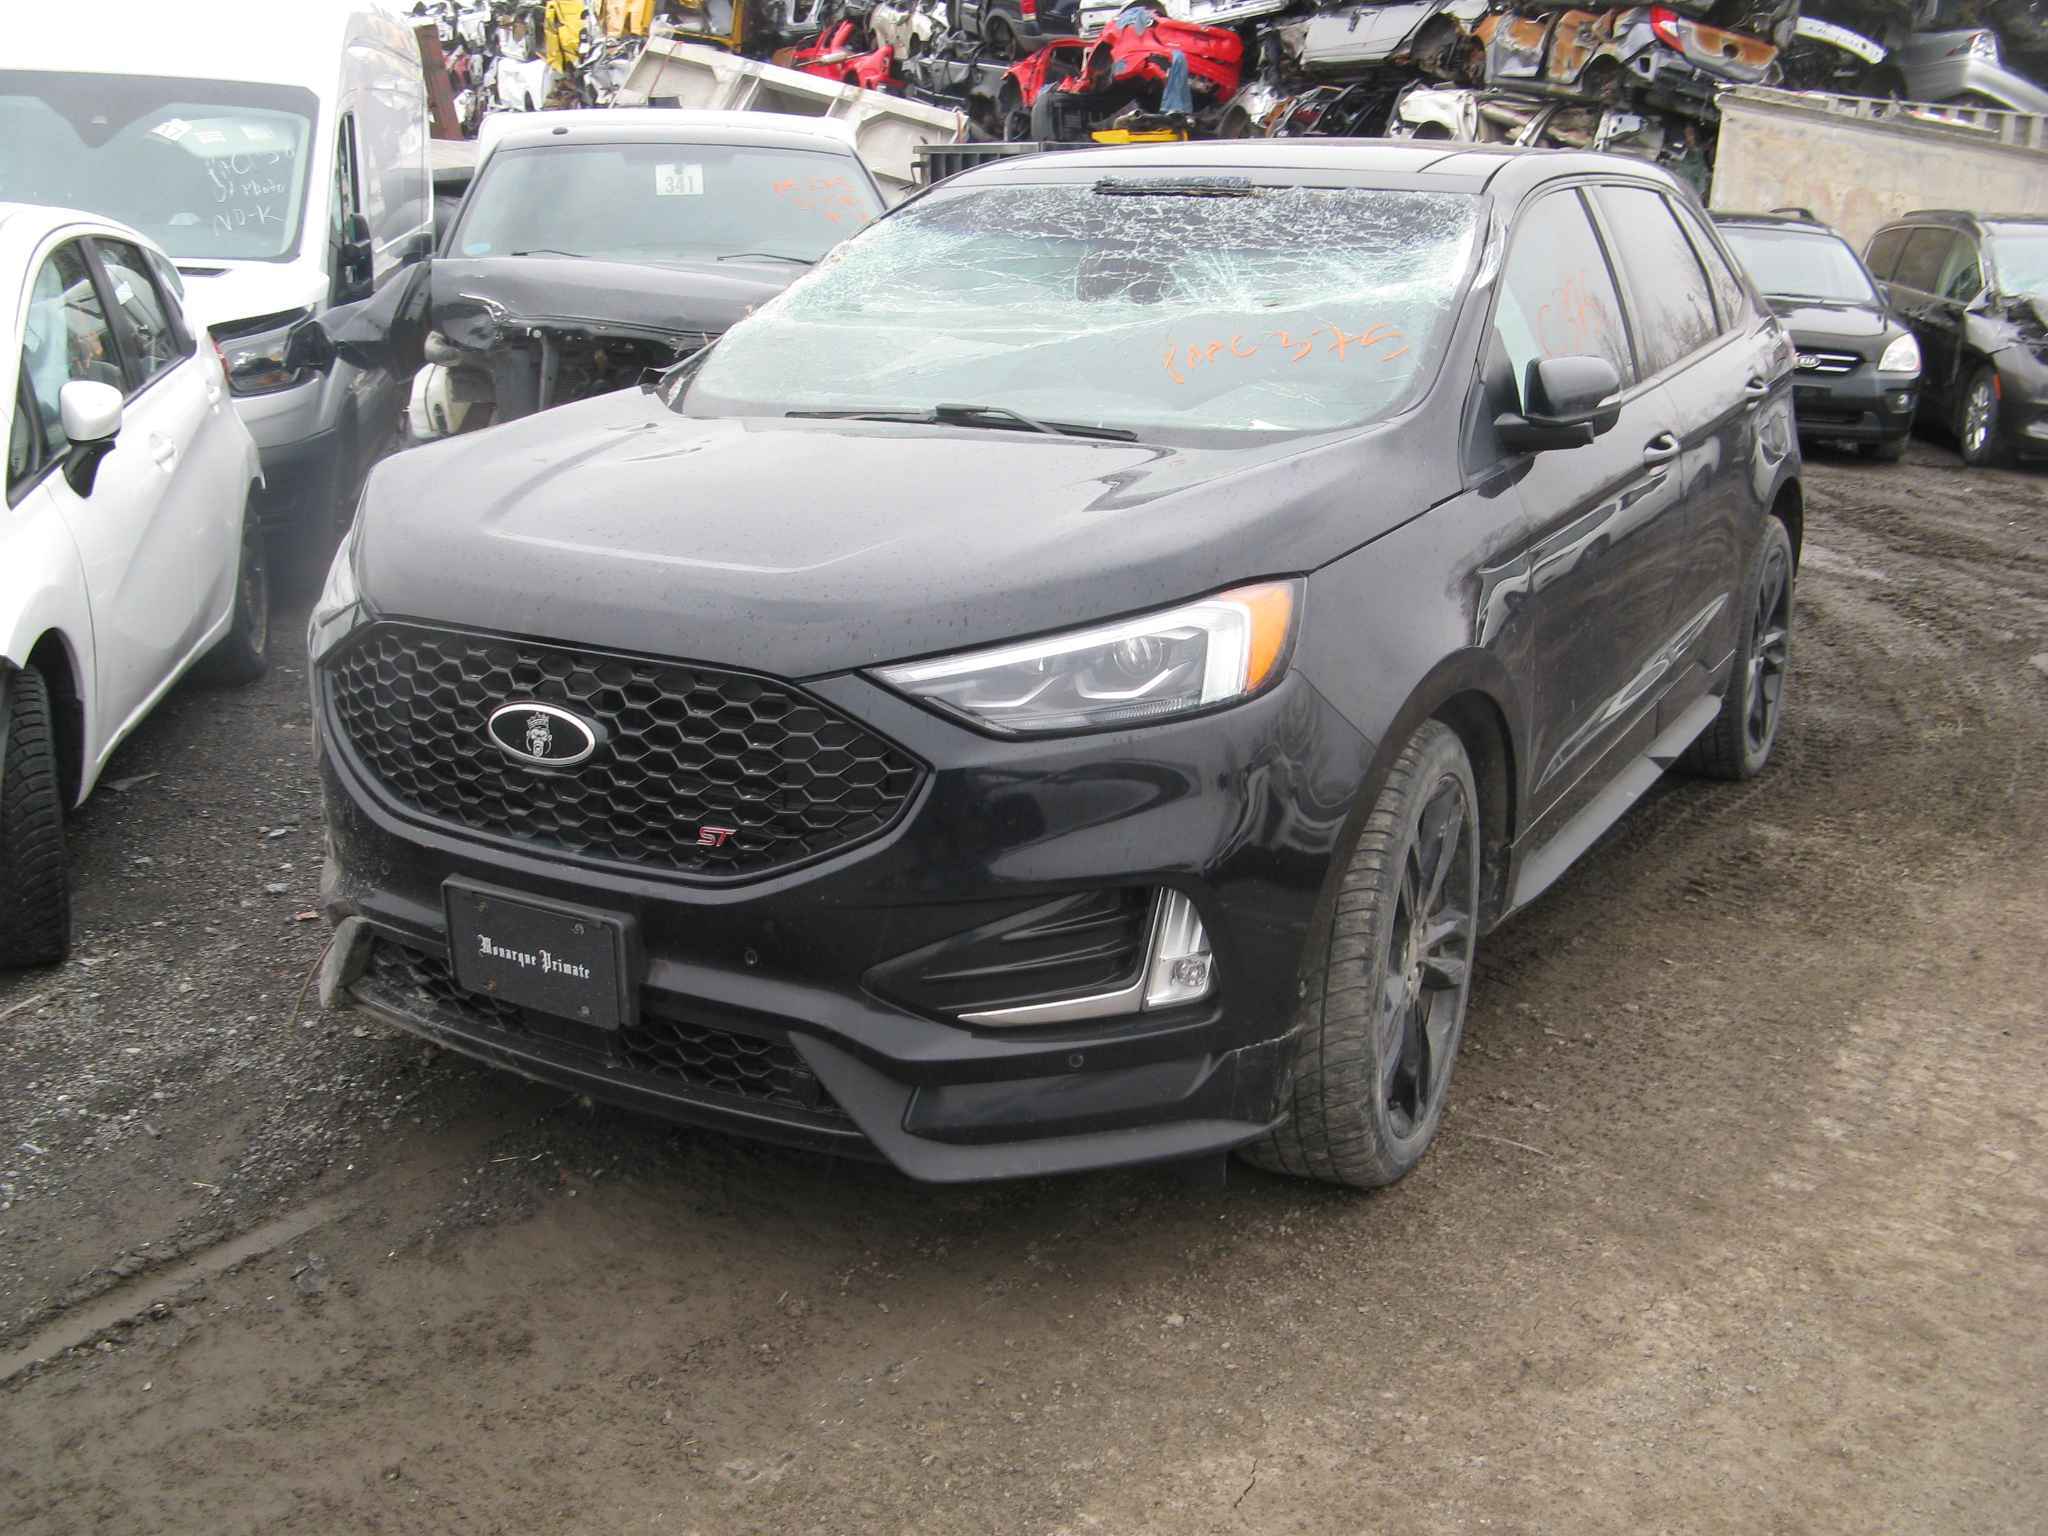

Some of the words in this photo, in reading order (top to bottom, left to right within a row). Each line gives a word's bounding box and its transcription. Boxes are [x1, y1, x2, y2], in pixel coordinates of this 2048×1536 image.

[663, 175, 694, 193] 341
[696, 826, 736, 847] ST
[478, 934, 537, 968] Monarque
[539, 949, 591, 979] Primate
